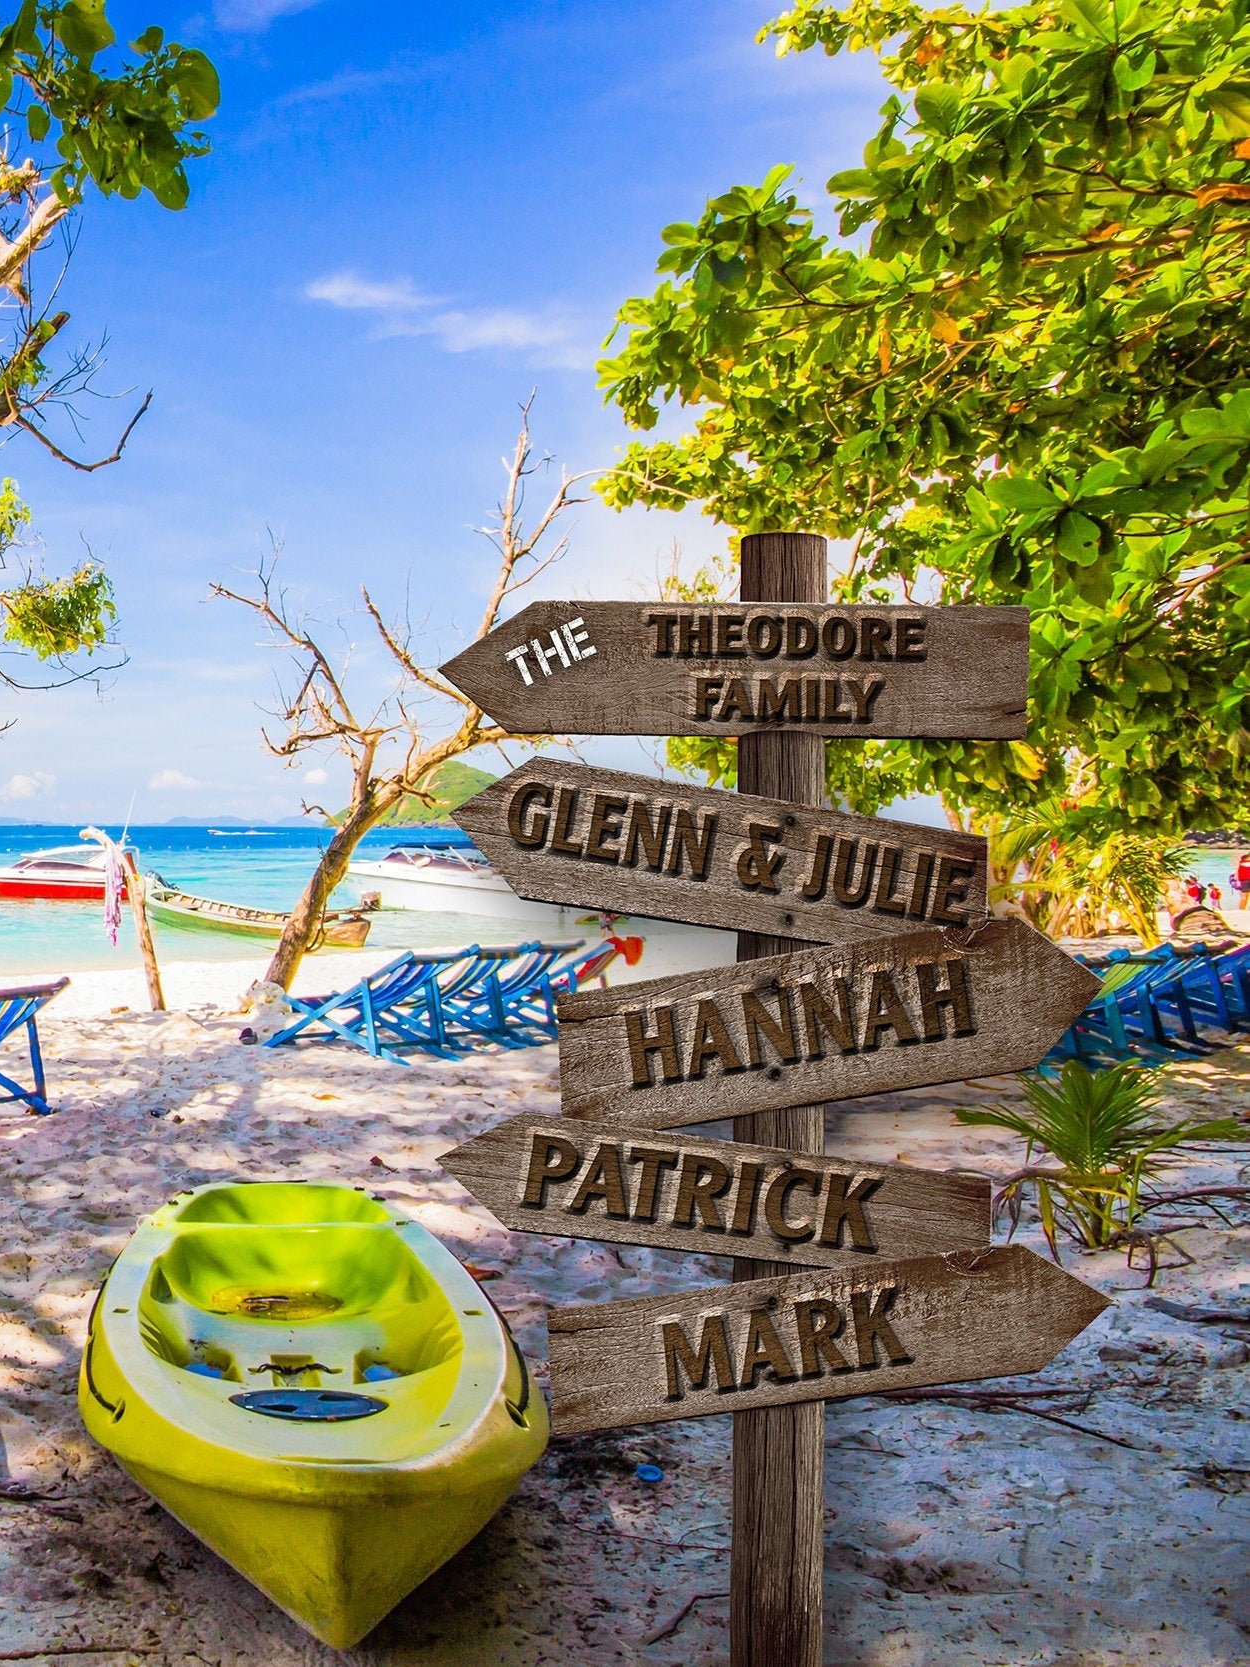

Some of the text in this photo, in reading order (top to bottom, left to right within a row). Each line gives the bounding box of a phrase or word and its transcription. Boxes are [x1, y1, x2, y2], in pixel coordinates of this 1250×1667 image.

[505, 617, 597, 686] THE
[651, 612, 927, 660] THEODORE
[695, 677, 882, 720] FAMILY
[507, 783, 977, 924] GLENN & JULIE
[625, 961, 976, 1088] HANNAH
[522, 1134, 882, 1252] PATRICK
[661, 1288, 913, 1400] MARK
